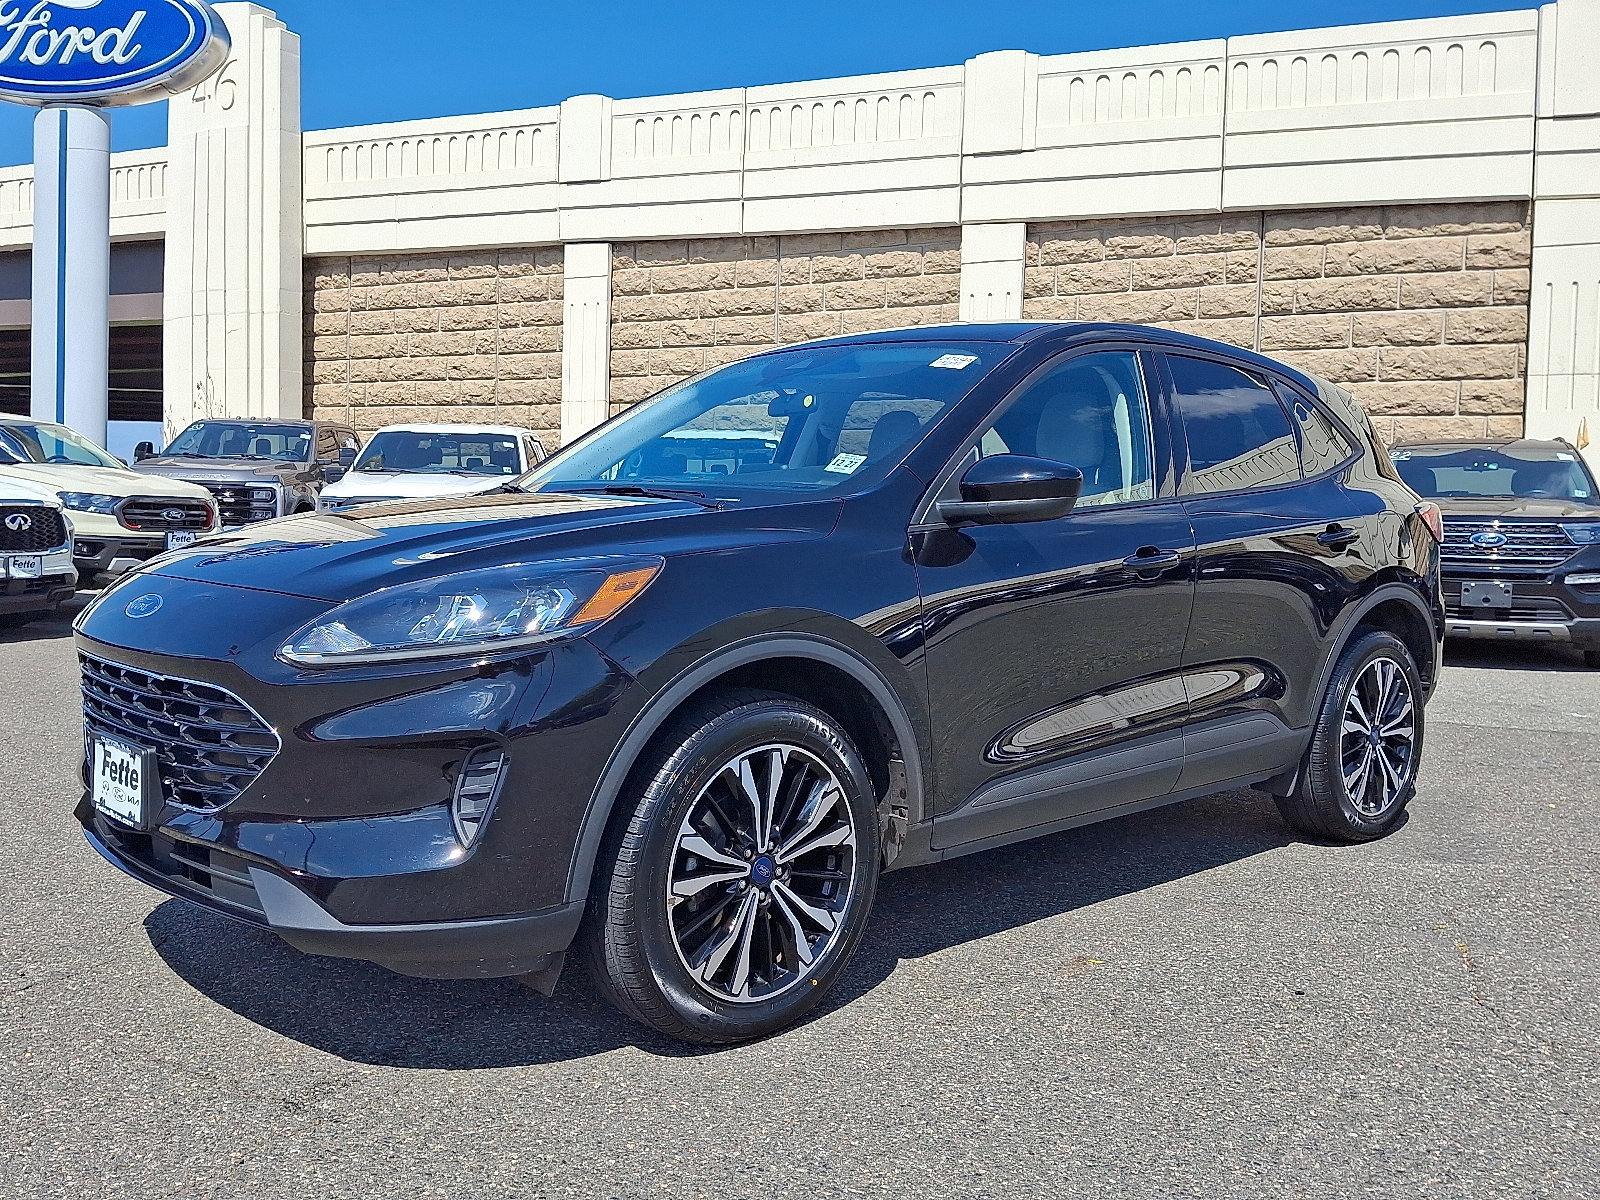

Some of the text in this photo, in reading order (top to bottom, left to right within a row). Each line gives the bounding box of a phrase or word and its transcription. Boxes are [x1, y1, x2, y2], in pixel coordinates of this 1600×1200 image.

[0, 0, 147, 65] Ford
[171, 534, 192, 544] Fette
[12, 559, 36, 569] Fette
[101, 749, 139, 790] Fette
